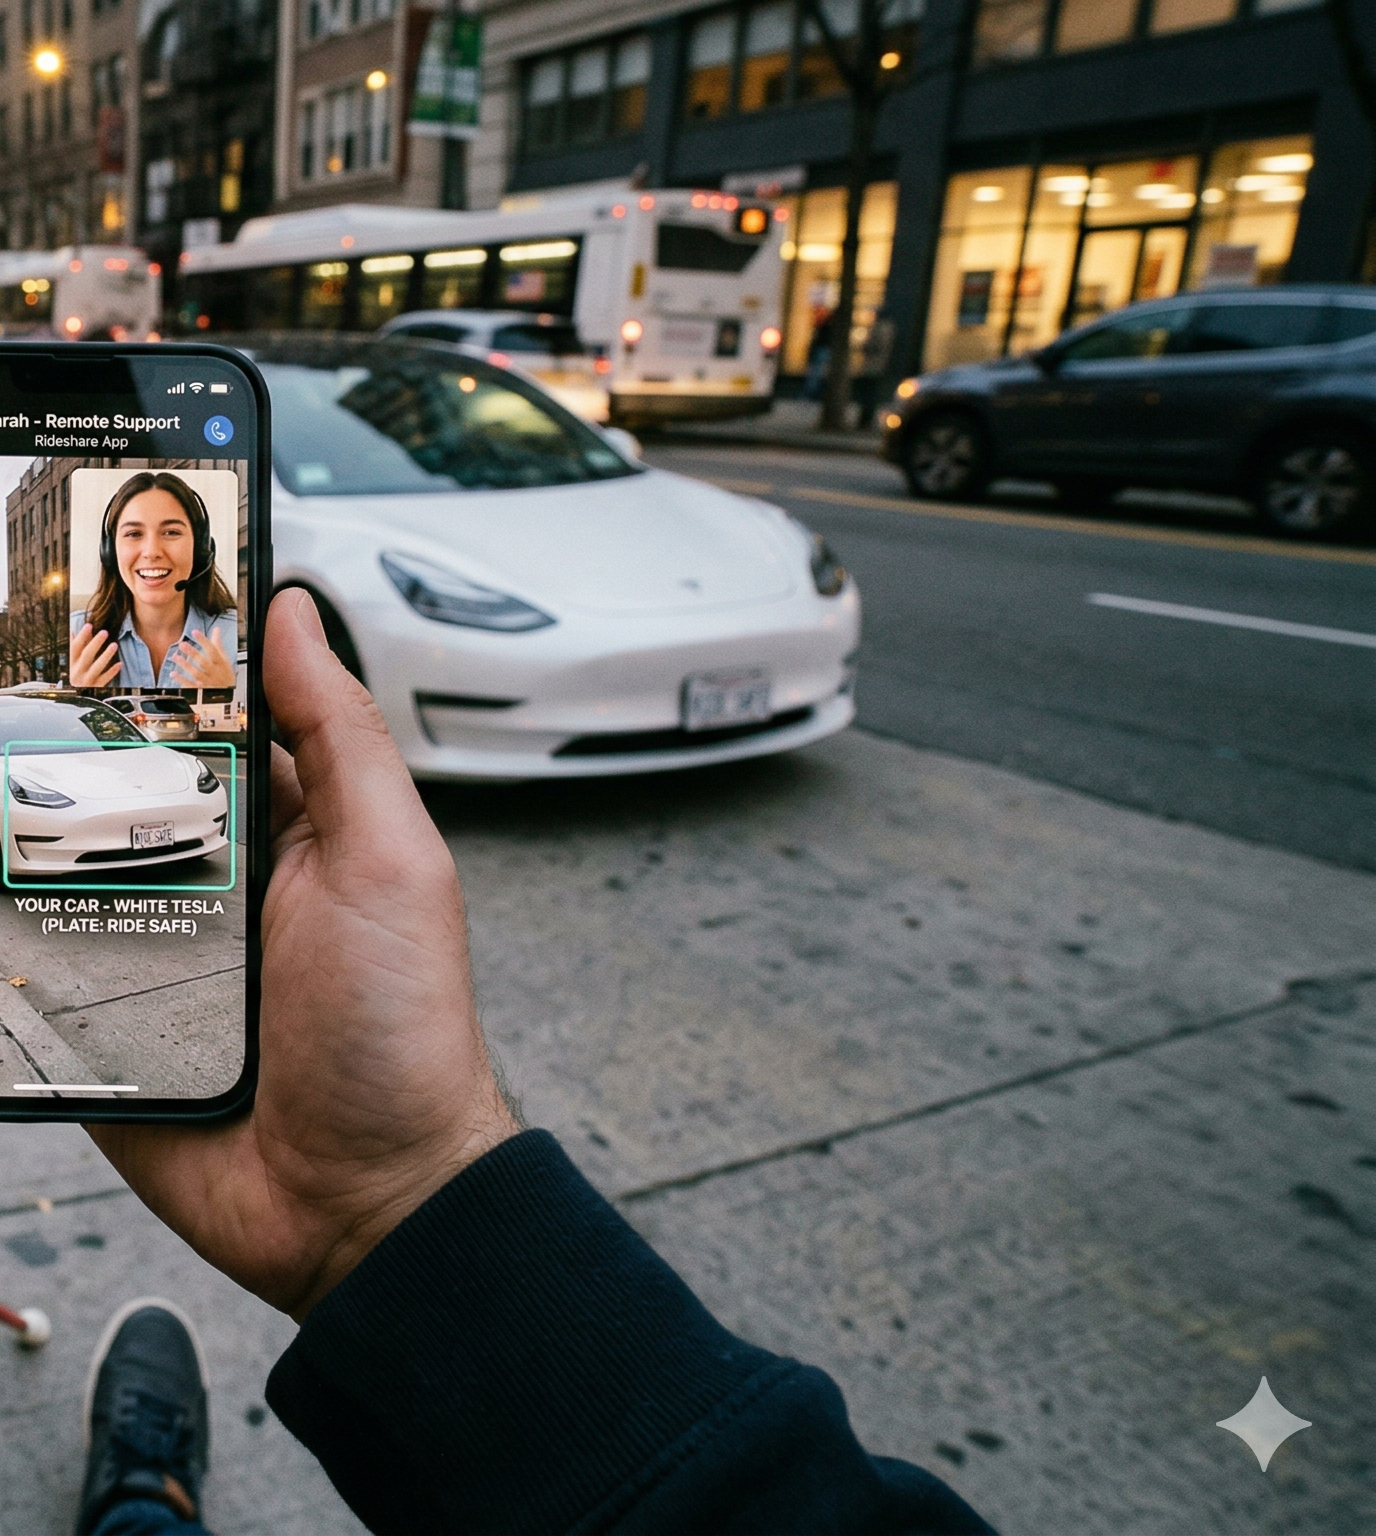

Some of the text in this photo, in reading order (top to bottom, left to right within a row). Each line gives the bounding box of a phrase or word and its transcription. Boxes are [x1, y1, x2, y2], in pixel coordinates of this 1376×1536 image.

[46, 414, 109, 429] Remote
[113, 414, 180, 432] Support
[35, 434, 128, 449] Rideshare App
[15, 898, 61, 913] YOUR
[64, 898, 99, 913] CAR
[114, 899, 168, 913] WHITE
[171, 899, 224, 914] TESLA
[42, 918, 197, 936] (PLATE: RIDE SAFE)
